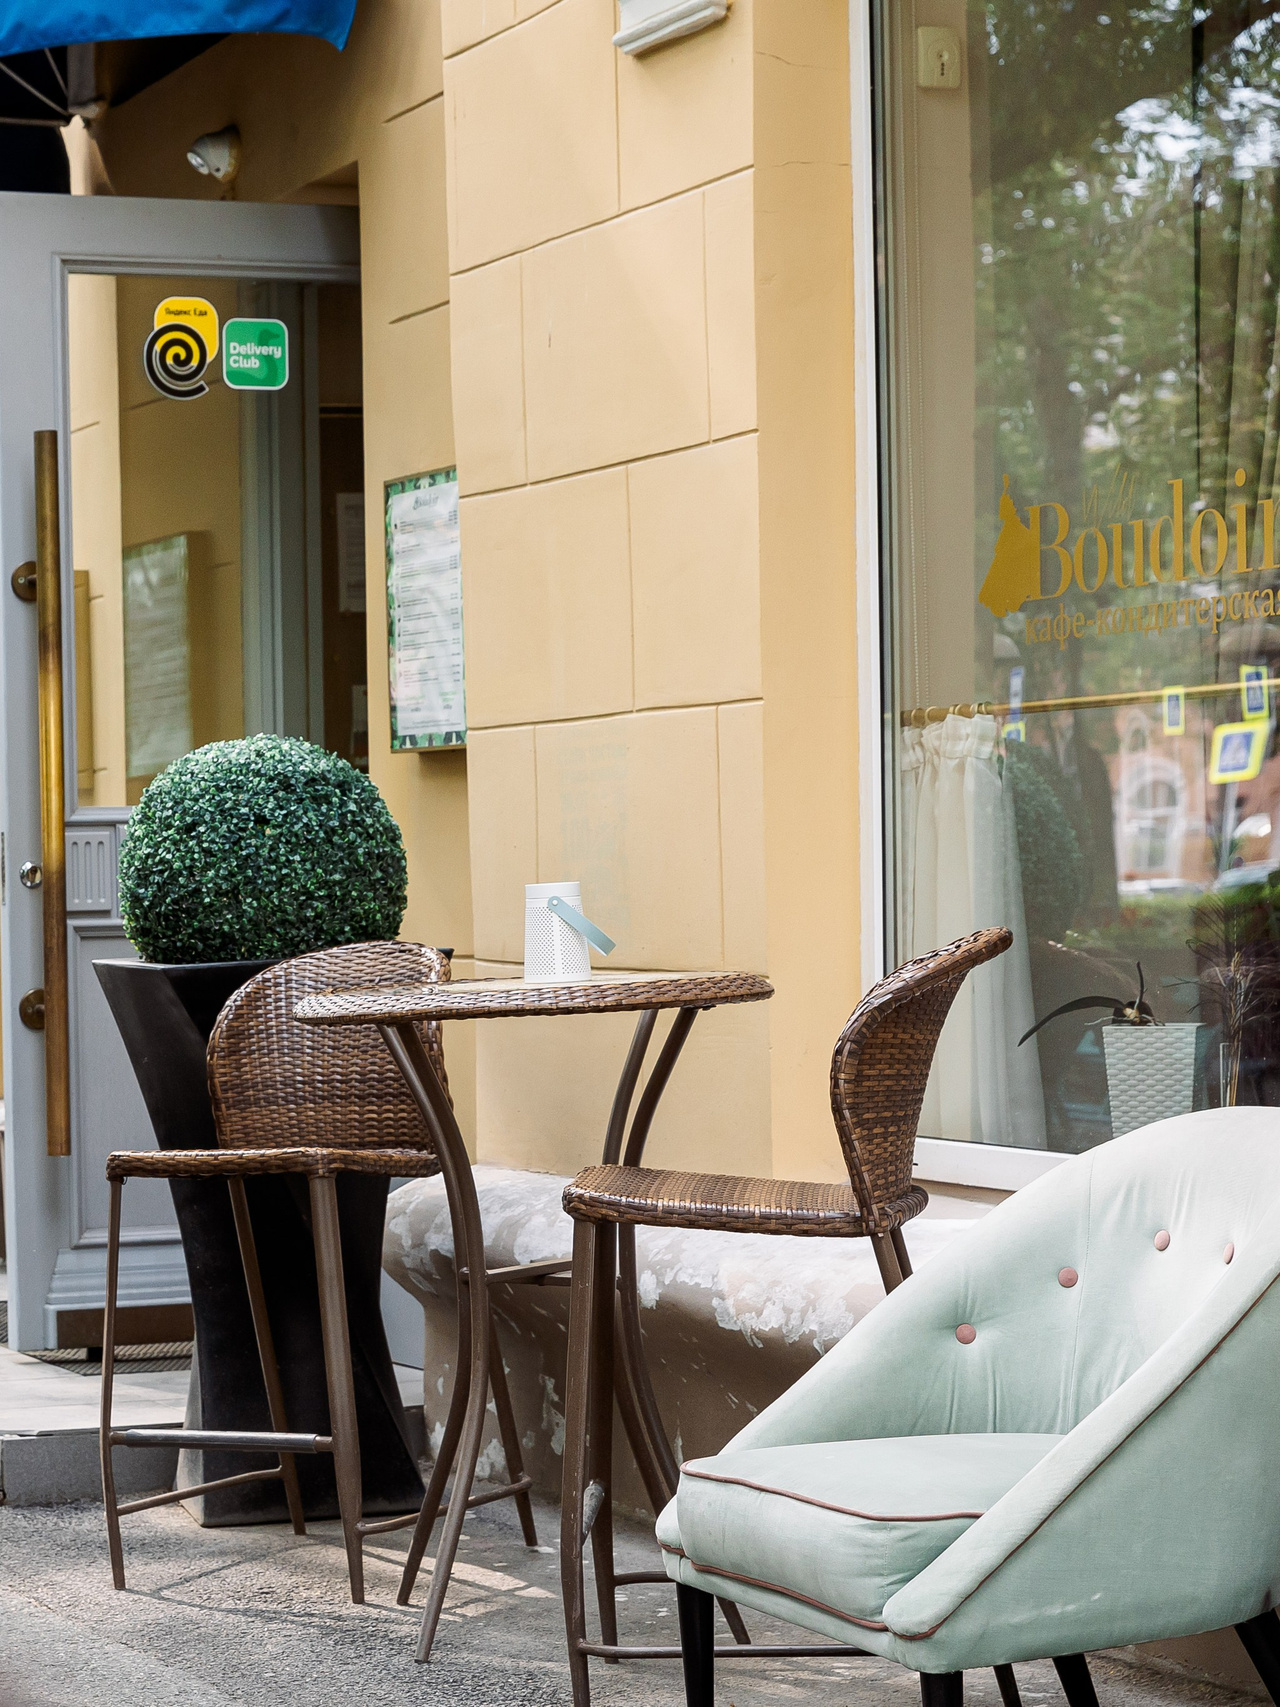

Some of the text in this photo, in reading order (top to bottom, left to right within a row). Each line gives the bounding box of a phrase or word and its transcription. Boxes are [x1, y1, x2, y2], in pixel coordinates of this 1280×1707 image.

[229, 341, 282, 359] Delivery
[229, 356, 260, 369] Club
[1025, 587, 1280, 651] кафе-кондитерска
